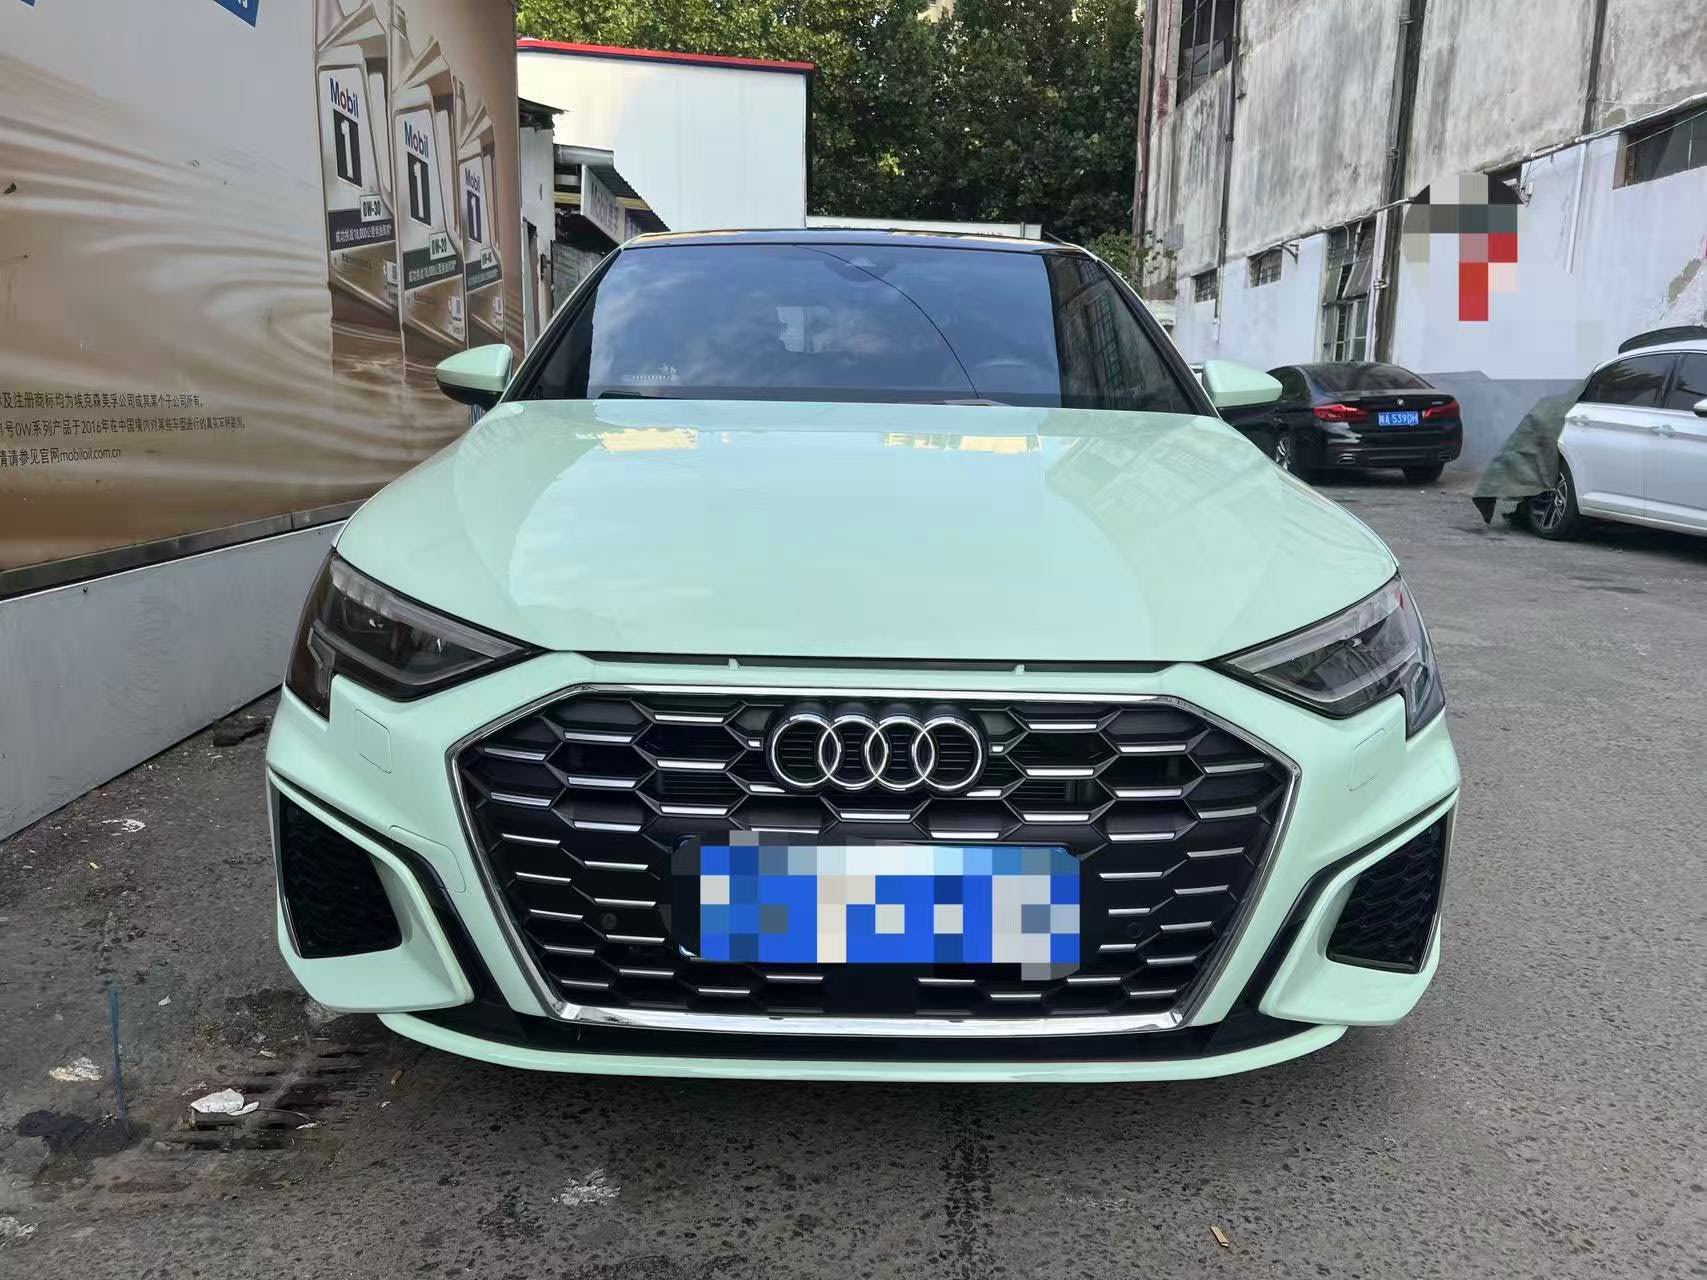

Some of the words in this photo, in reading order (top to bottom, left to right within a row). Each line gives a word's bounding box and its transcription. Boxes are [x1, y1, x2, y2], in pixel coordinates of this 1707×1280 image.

[329, 77, 359, 118] Mobil
[340, 119, 354, 179] 1
[404, 120, 429, 159] Mobil
[413, 161, 425, 219] 1
[464, 167, 481, 194] Mobil
[0, 391, 204, 409] 及注册商标均为埃克森美孚公司或其某个子公司所有。
